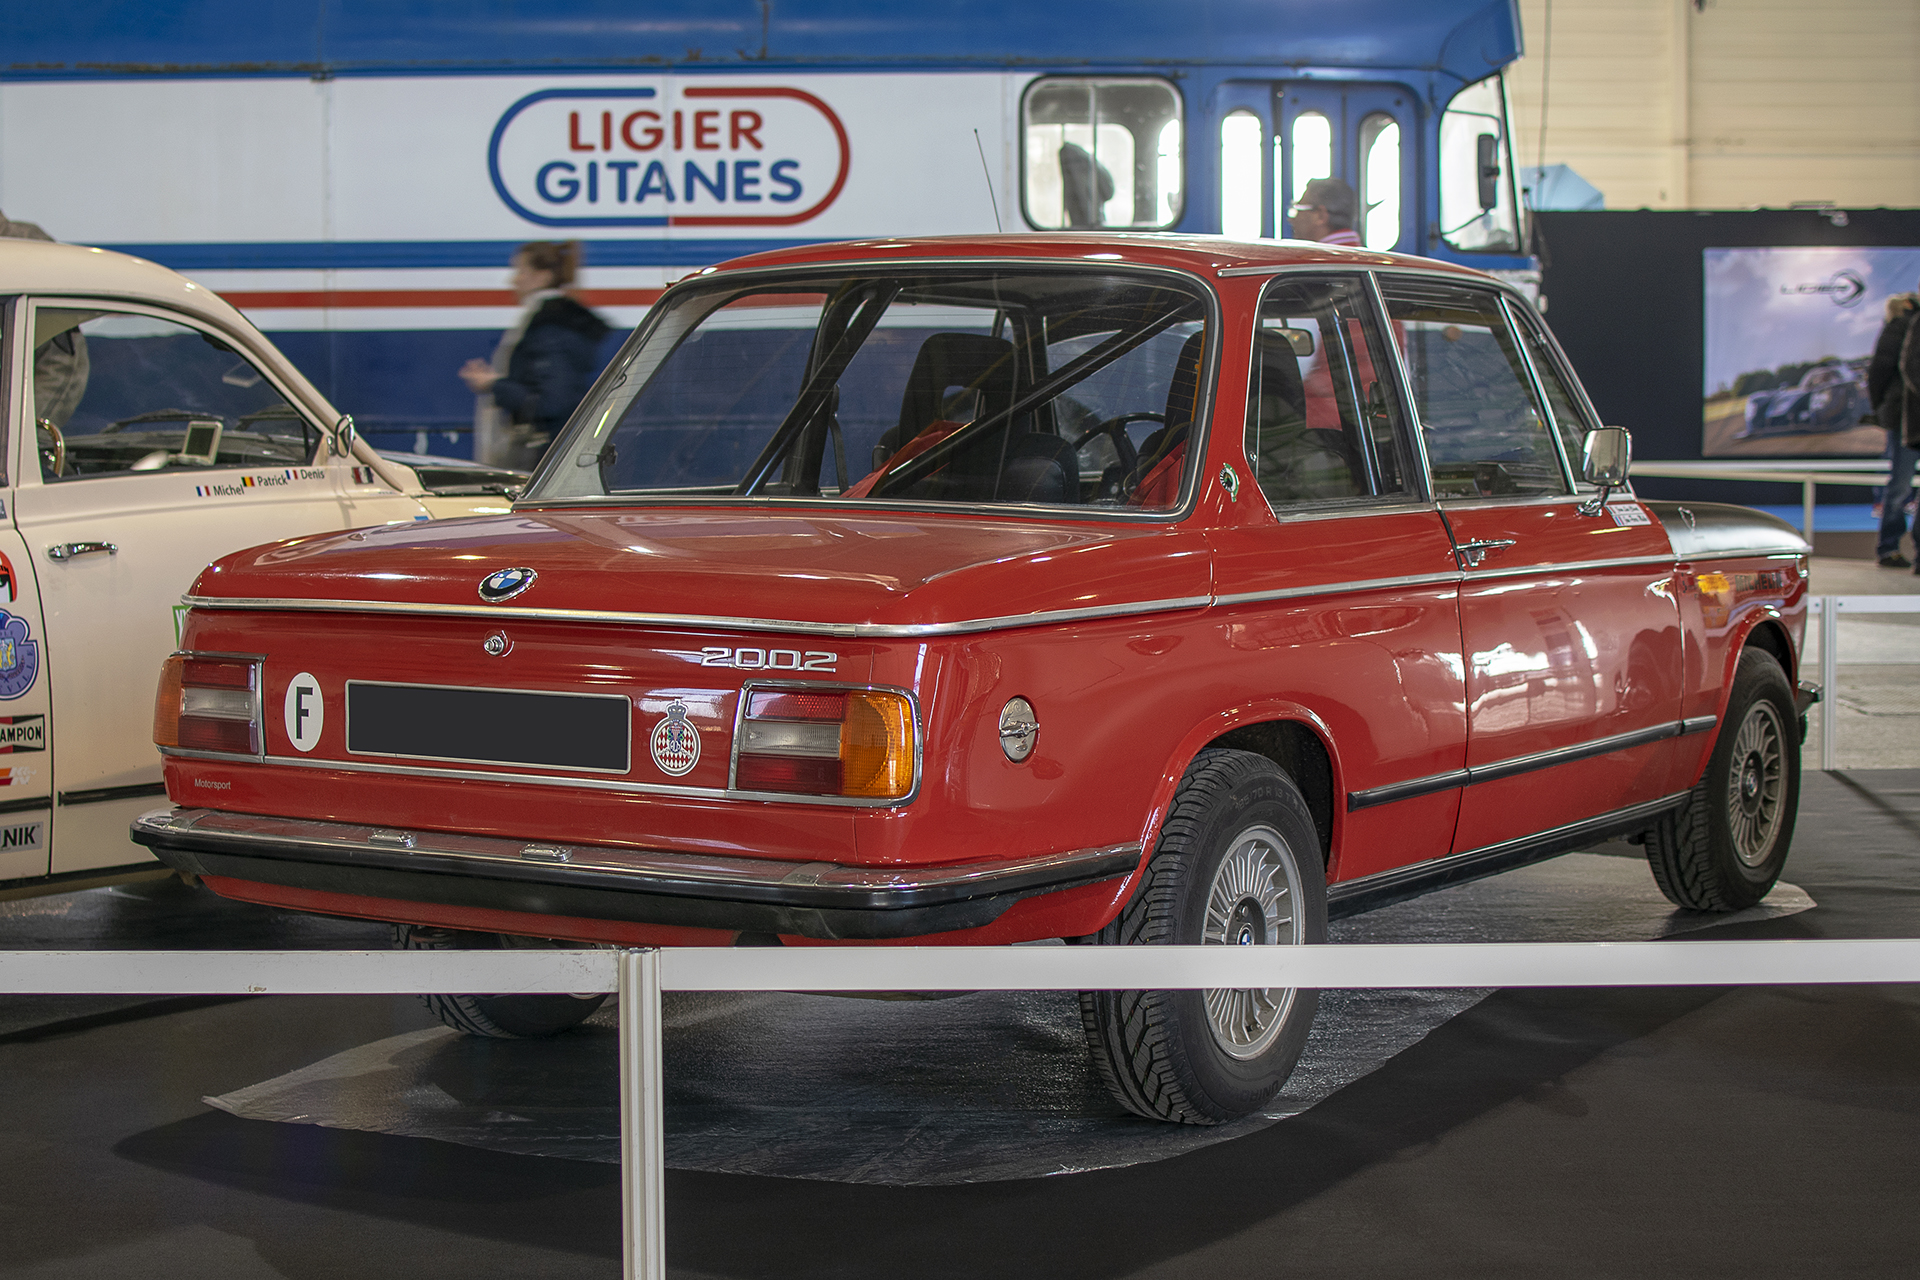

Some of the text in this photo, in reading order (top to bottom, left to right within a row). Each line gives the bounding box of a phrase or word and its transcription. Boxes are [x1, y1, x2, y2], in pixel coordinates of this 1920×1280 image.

[569, 110, 763, 152] LIGIER
[535, 160, 803, 204] GITANES
[213, 469, 325, 496] Michel Patrick Denis
[700, 646, 837, 673] 2002
[296, 686, 313, 740] F
[194, 778, 231, 791] Motorsport
[2, 826, 36, 848] NIK
